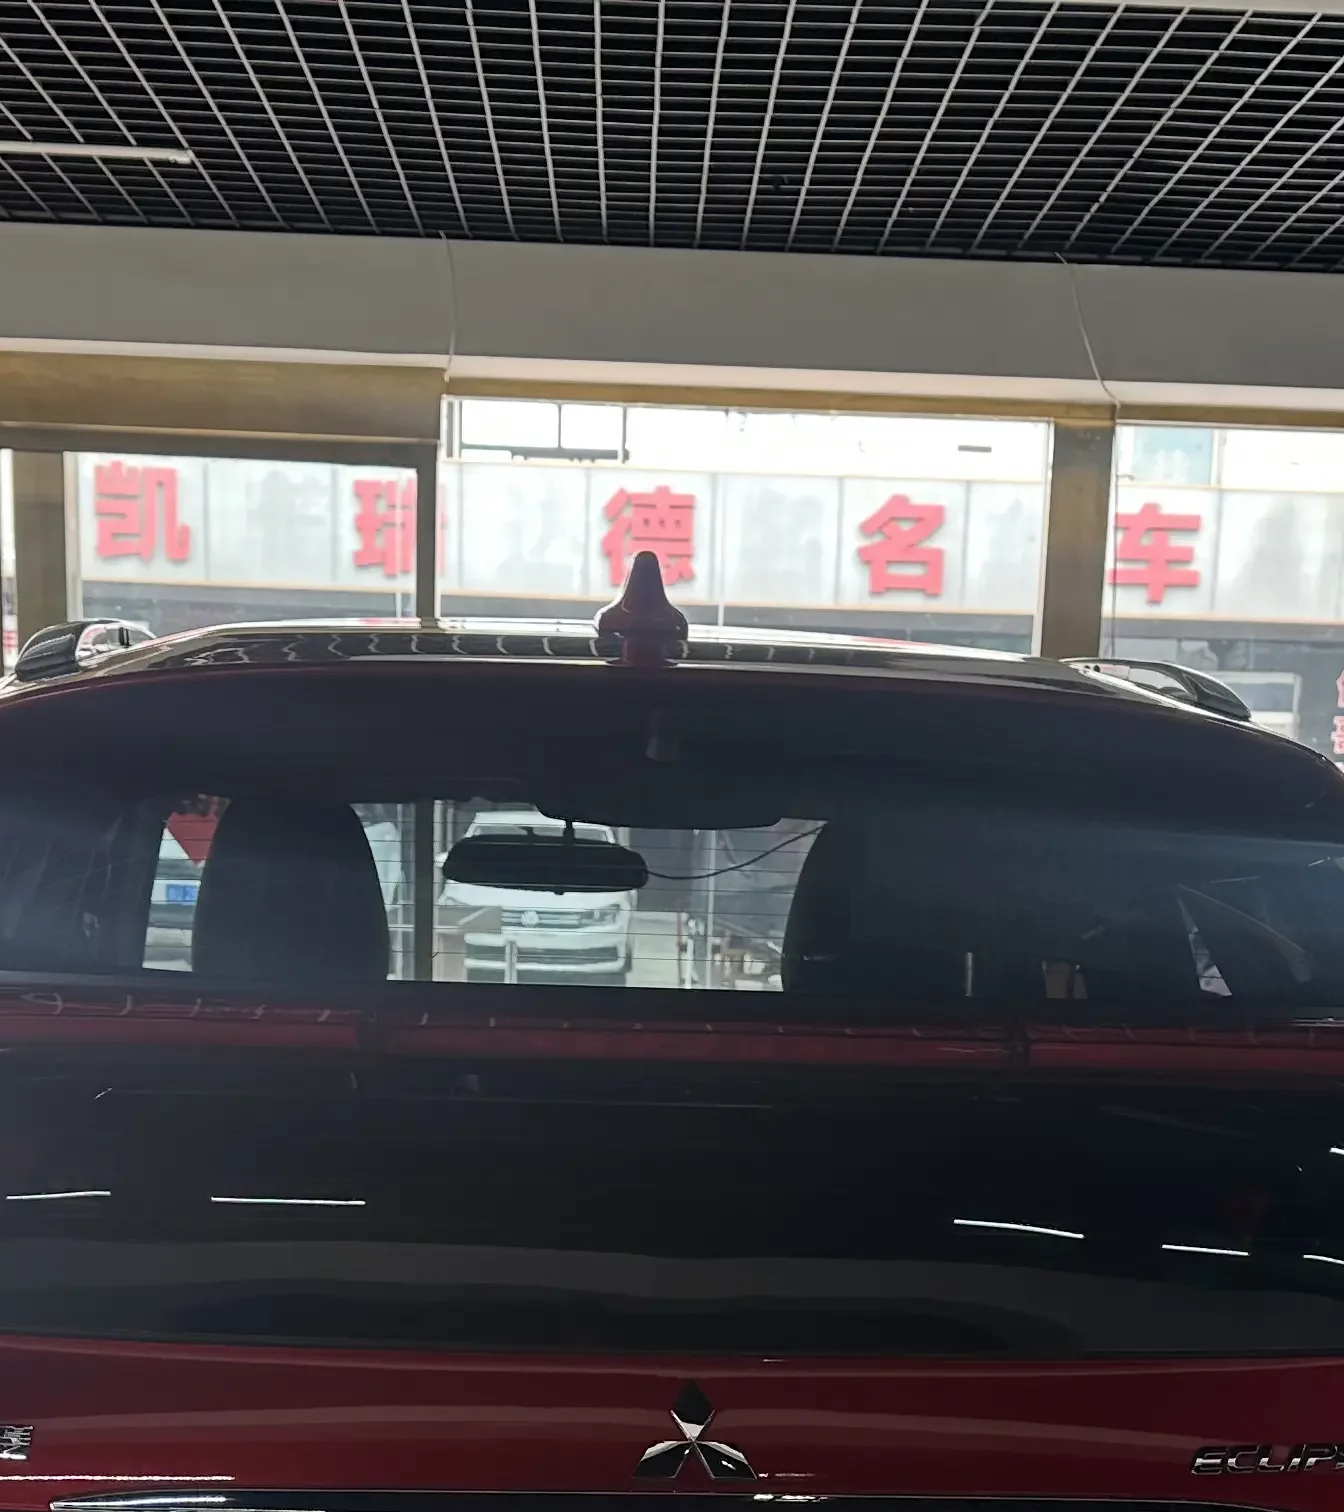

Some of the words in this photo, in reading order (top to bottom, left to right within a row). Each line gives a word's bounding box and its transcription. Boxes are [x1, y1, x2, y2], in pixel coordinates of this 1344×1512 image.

[92, 460, 1203, 604] 凯瑞德名车
